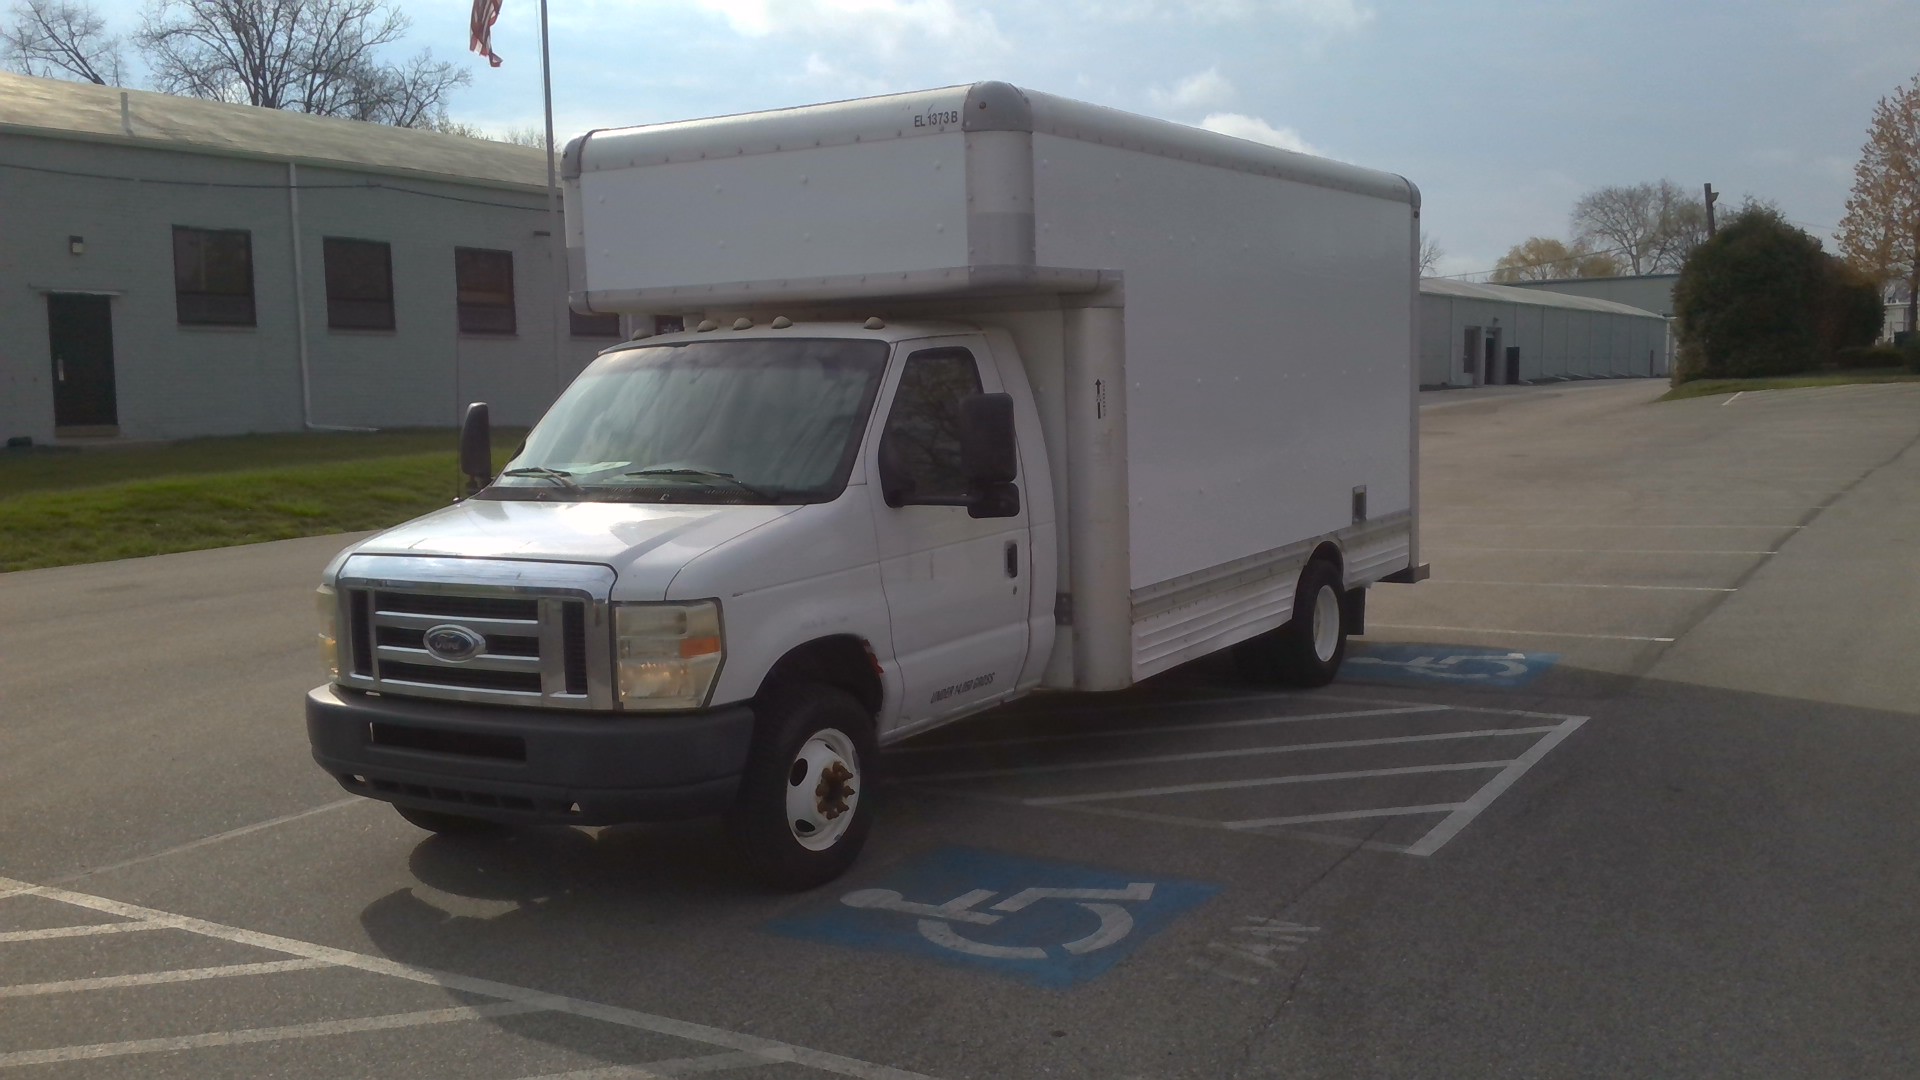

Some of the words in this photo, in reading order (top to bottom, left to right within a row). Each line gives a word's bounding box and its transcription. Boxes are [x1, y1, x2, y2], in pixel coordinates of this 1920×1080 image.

[914, 115, 926, 128] EL
[930, 685, 955, 704] UNDER
[972, 672, 996, 690] GROSS
